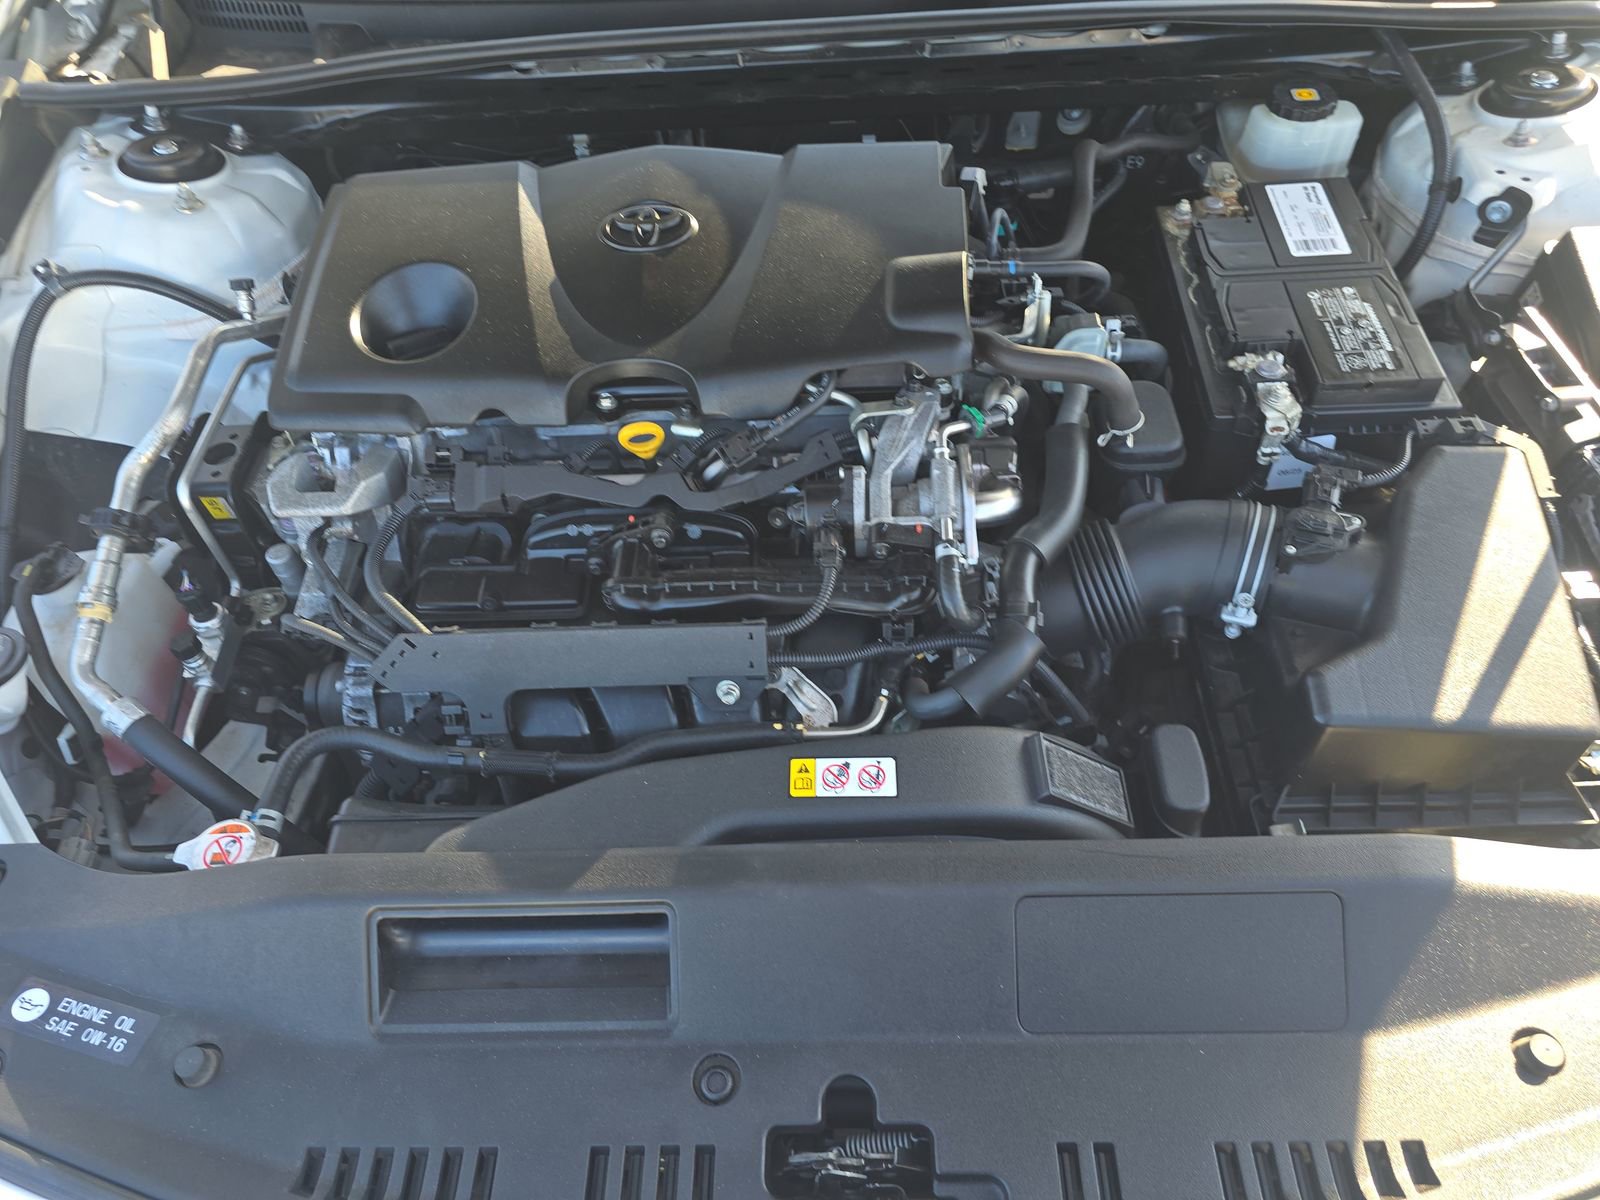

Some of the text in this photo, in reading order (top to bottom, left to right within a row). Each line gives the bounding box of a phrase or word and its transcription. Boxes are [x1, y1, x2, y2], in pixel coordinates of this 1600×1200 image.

[57, 997, 137, 1034] ENGINE OIL
[45, 1016, 128, 1053] SAE 0W-16
